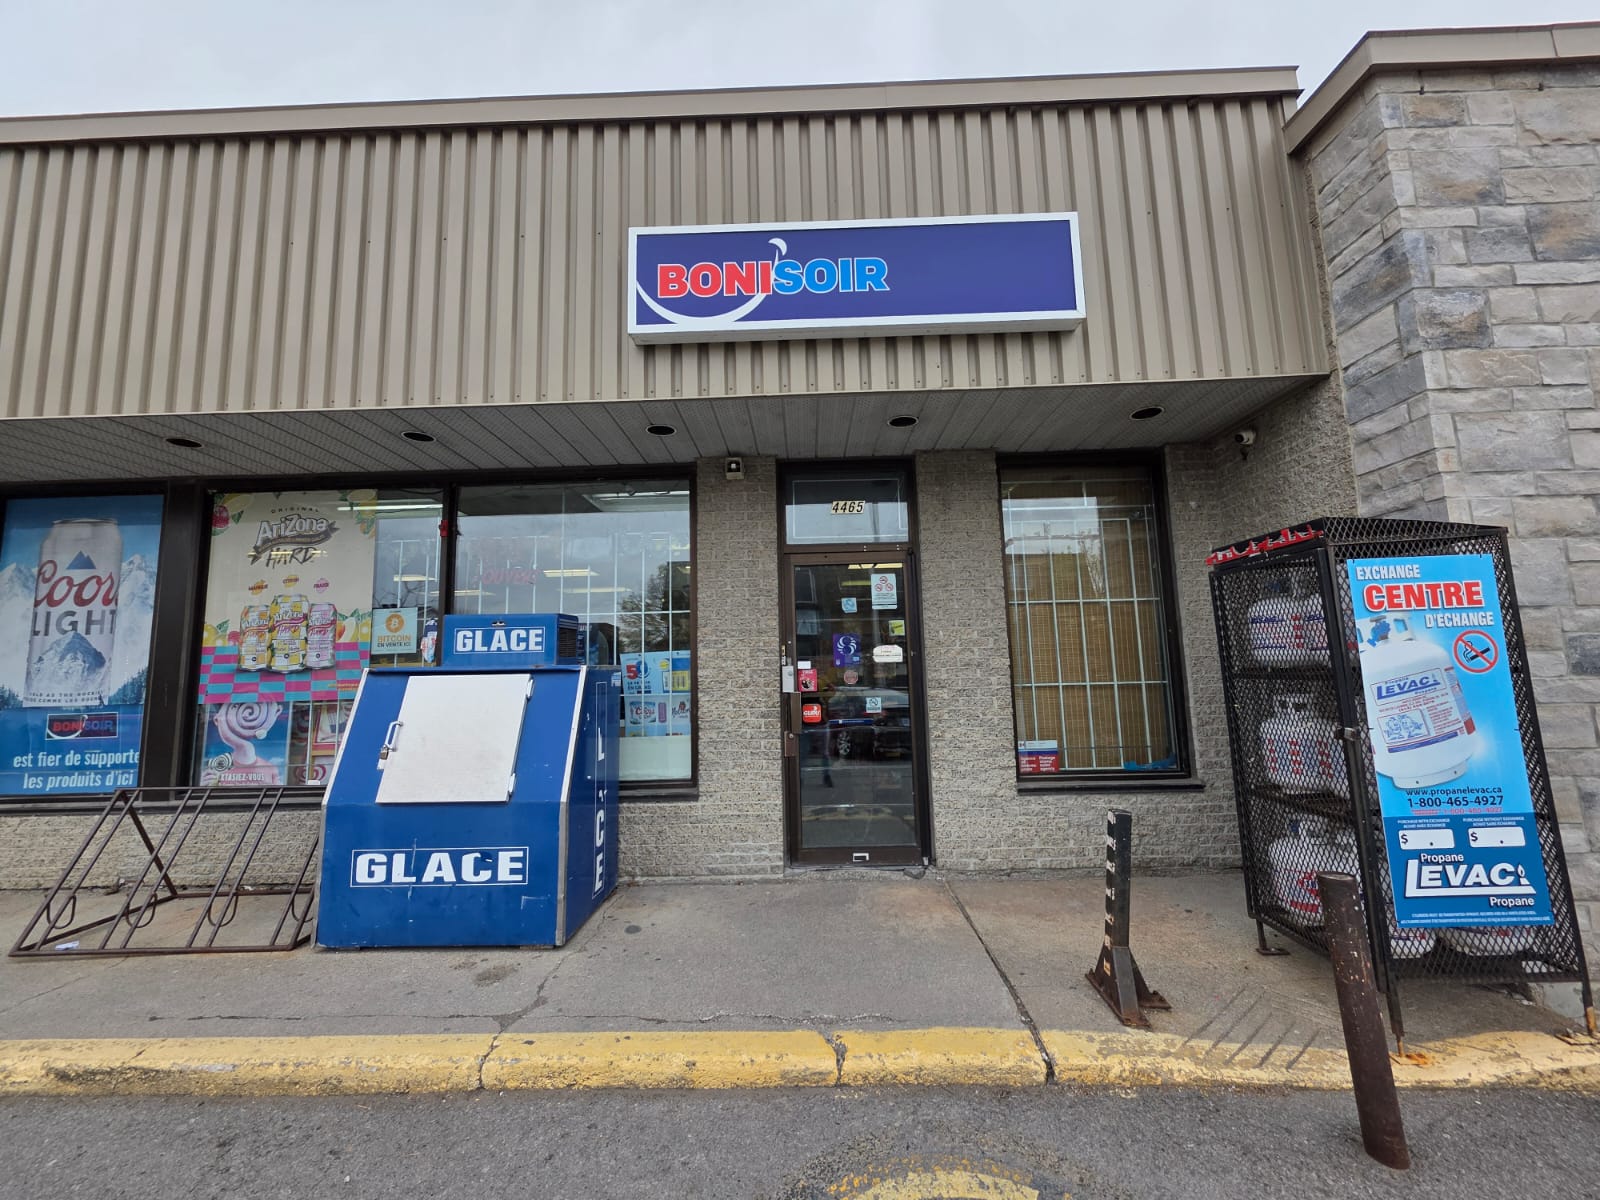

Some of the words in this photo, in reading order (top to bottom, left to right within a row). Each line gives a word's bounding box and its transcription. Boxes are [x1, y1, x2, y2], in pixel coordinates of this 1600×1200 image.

[832, 501, 864, 513] 4465
[256, 513, 329, 547] AriZona
[1356, 564, 1421, 581] EXCHANGE
[1364, 581, 1485, 612] CENTRE
[377, 634, 411, 643] BITCOIN
[456, 629, 543, 651] GLACE
[1376, 676, 1440, 700] LEVAC
[13, 754, 33, 768] est
[38, 751, 62, 767] fier
[65, 750, 81, 766] de
[23, 773, 44, 789] les
[46, 771, 102, 791] produits
[105, 770, 134, 786] d'ici
[1405, 785, 1502, 797] www.propanelevac.ca
[1407, 795, 1504, 808] 1-800-465-4927
[354, 850, 525, 884] GLACE
[1420, 852, 1464, 864] Propane
[1405, 859, 1536, 898] LEVAC
[1489, 896, 1535, 908] Propane
